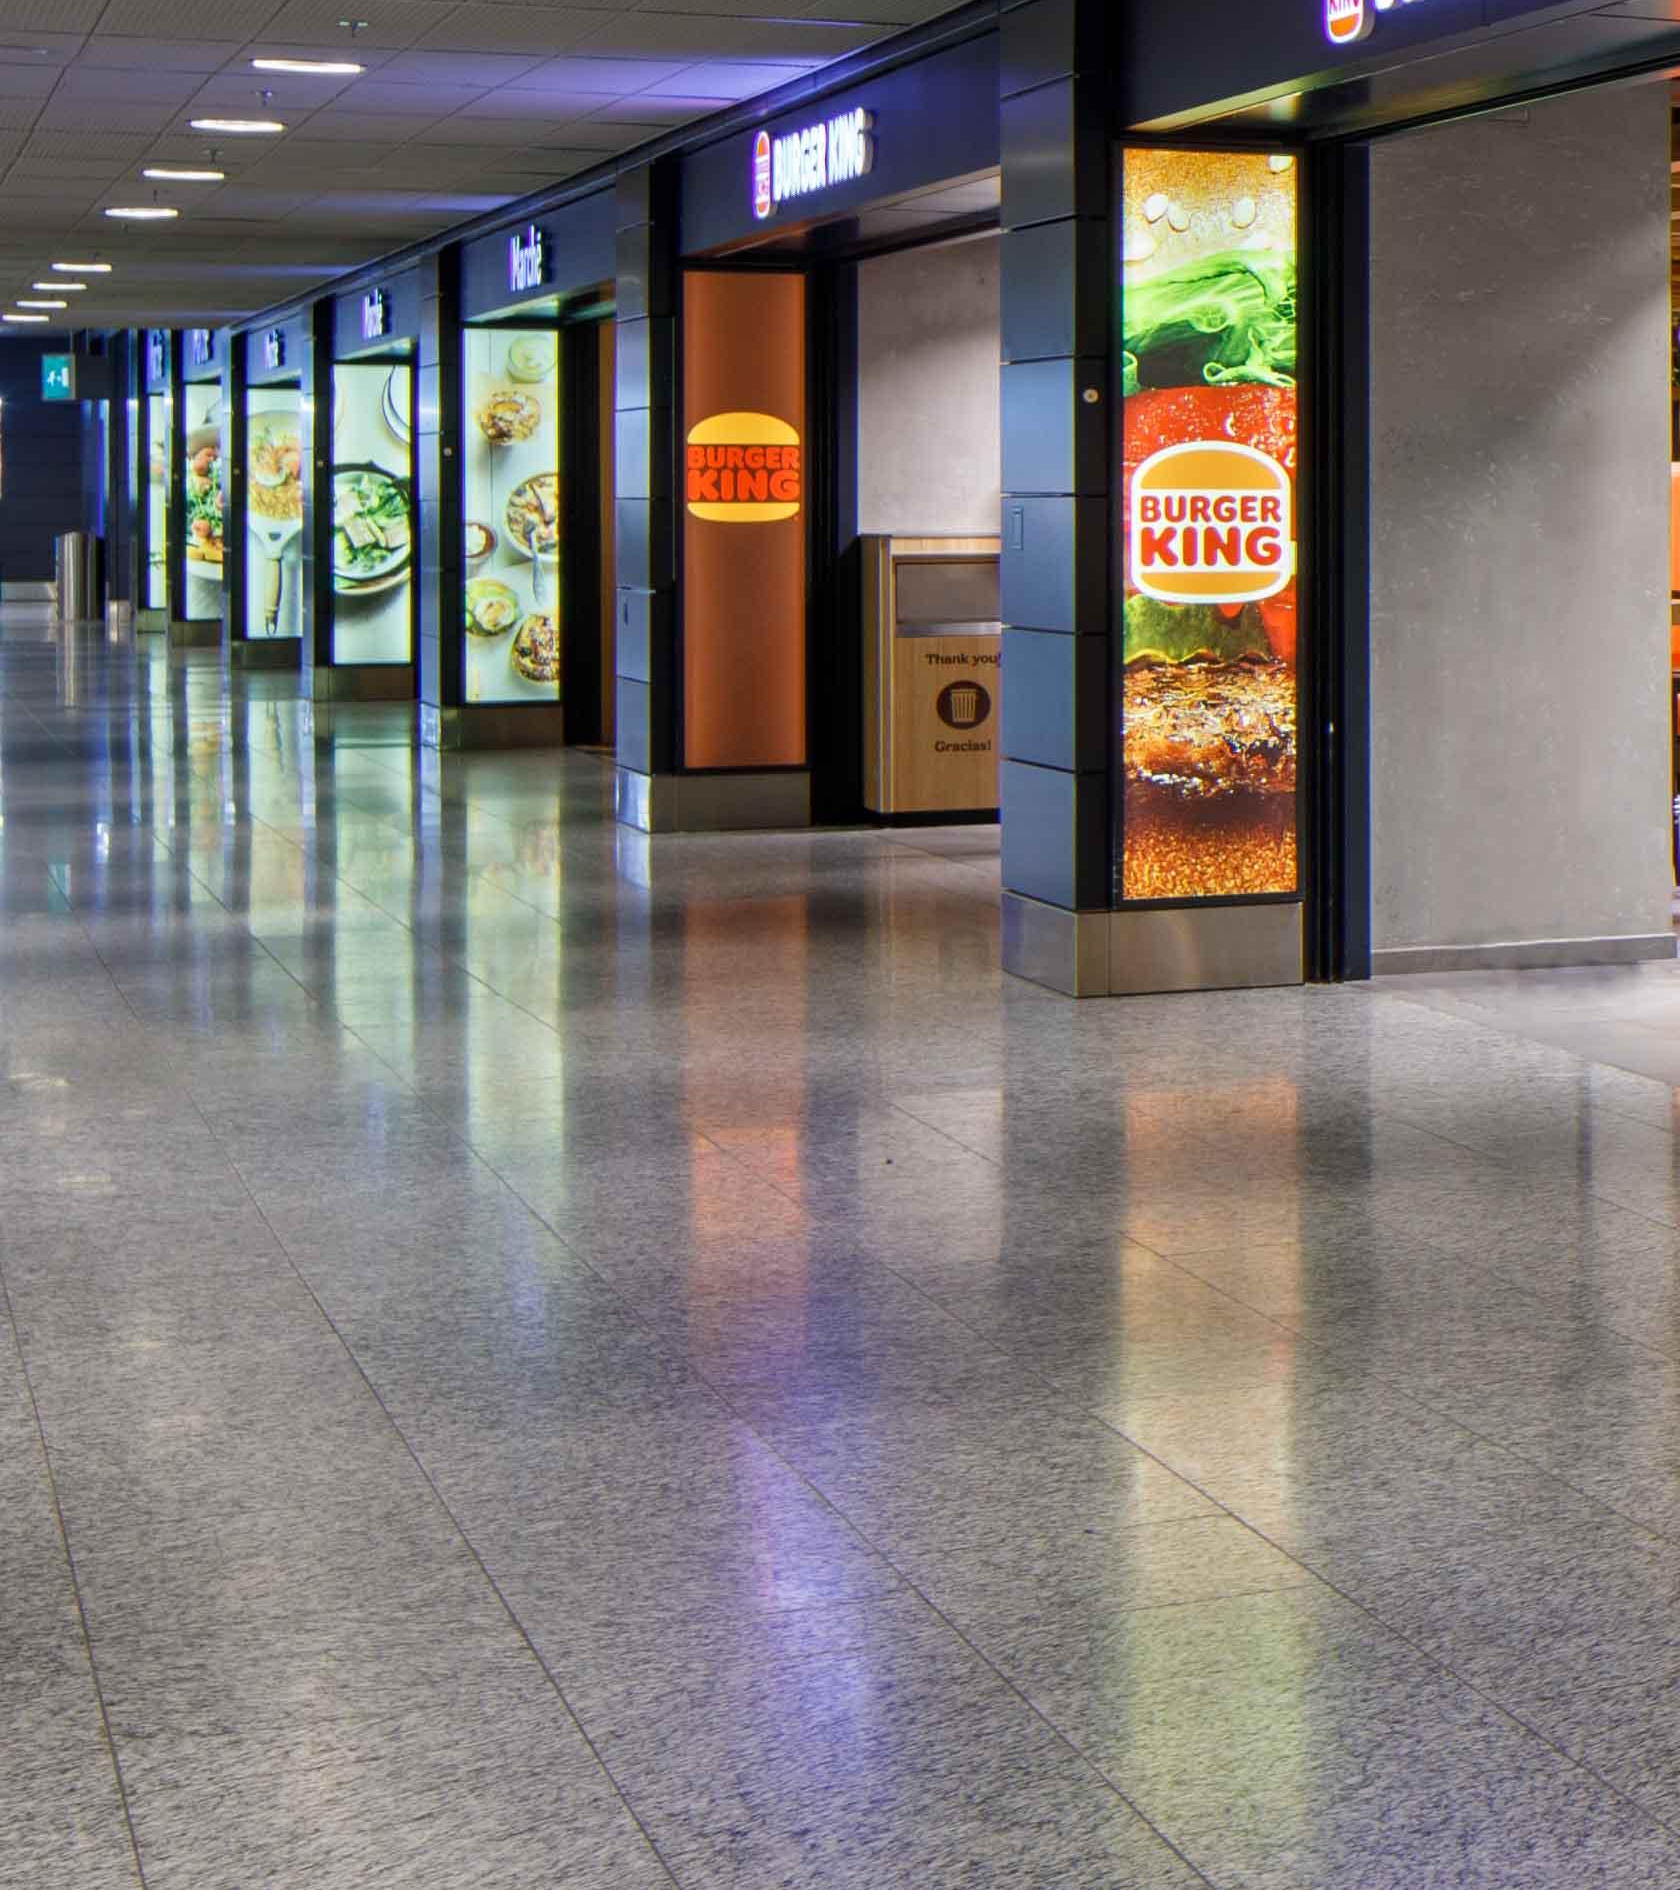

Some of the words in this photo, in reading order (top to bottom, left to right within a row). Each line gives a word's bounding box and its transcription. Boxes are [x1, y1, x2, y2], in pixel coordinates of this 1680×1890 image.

[772, 122, 827, 202] BURGER
[827, 106, 866, 186] KING
[686, 446, 800, 470] BURGER
[686, 469, 800, 501] KING
[1140, 495, 1282, 523] BURGER
[1140, 526, 1283, 567] KING
[926, 653, 969, 665] Thank
[934, 741, 992, 753] Gracias!
